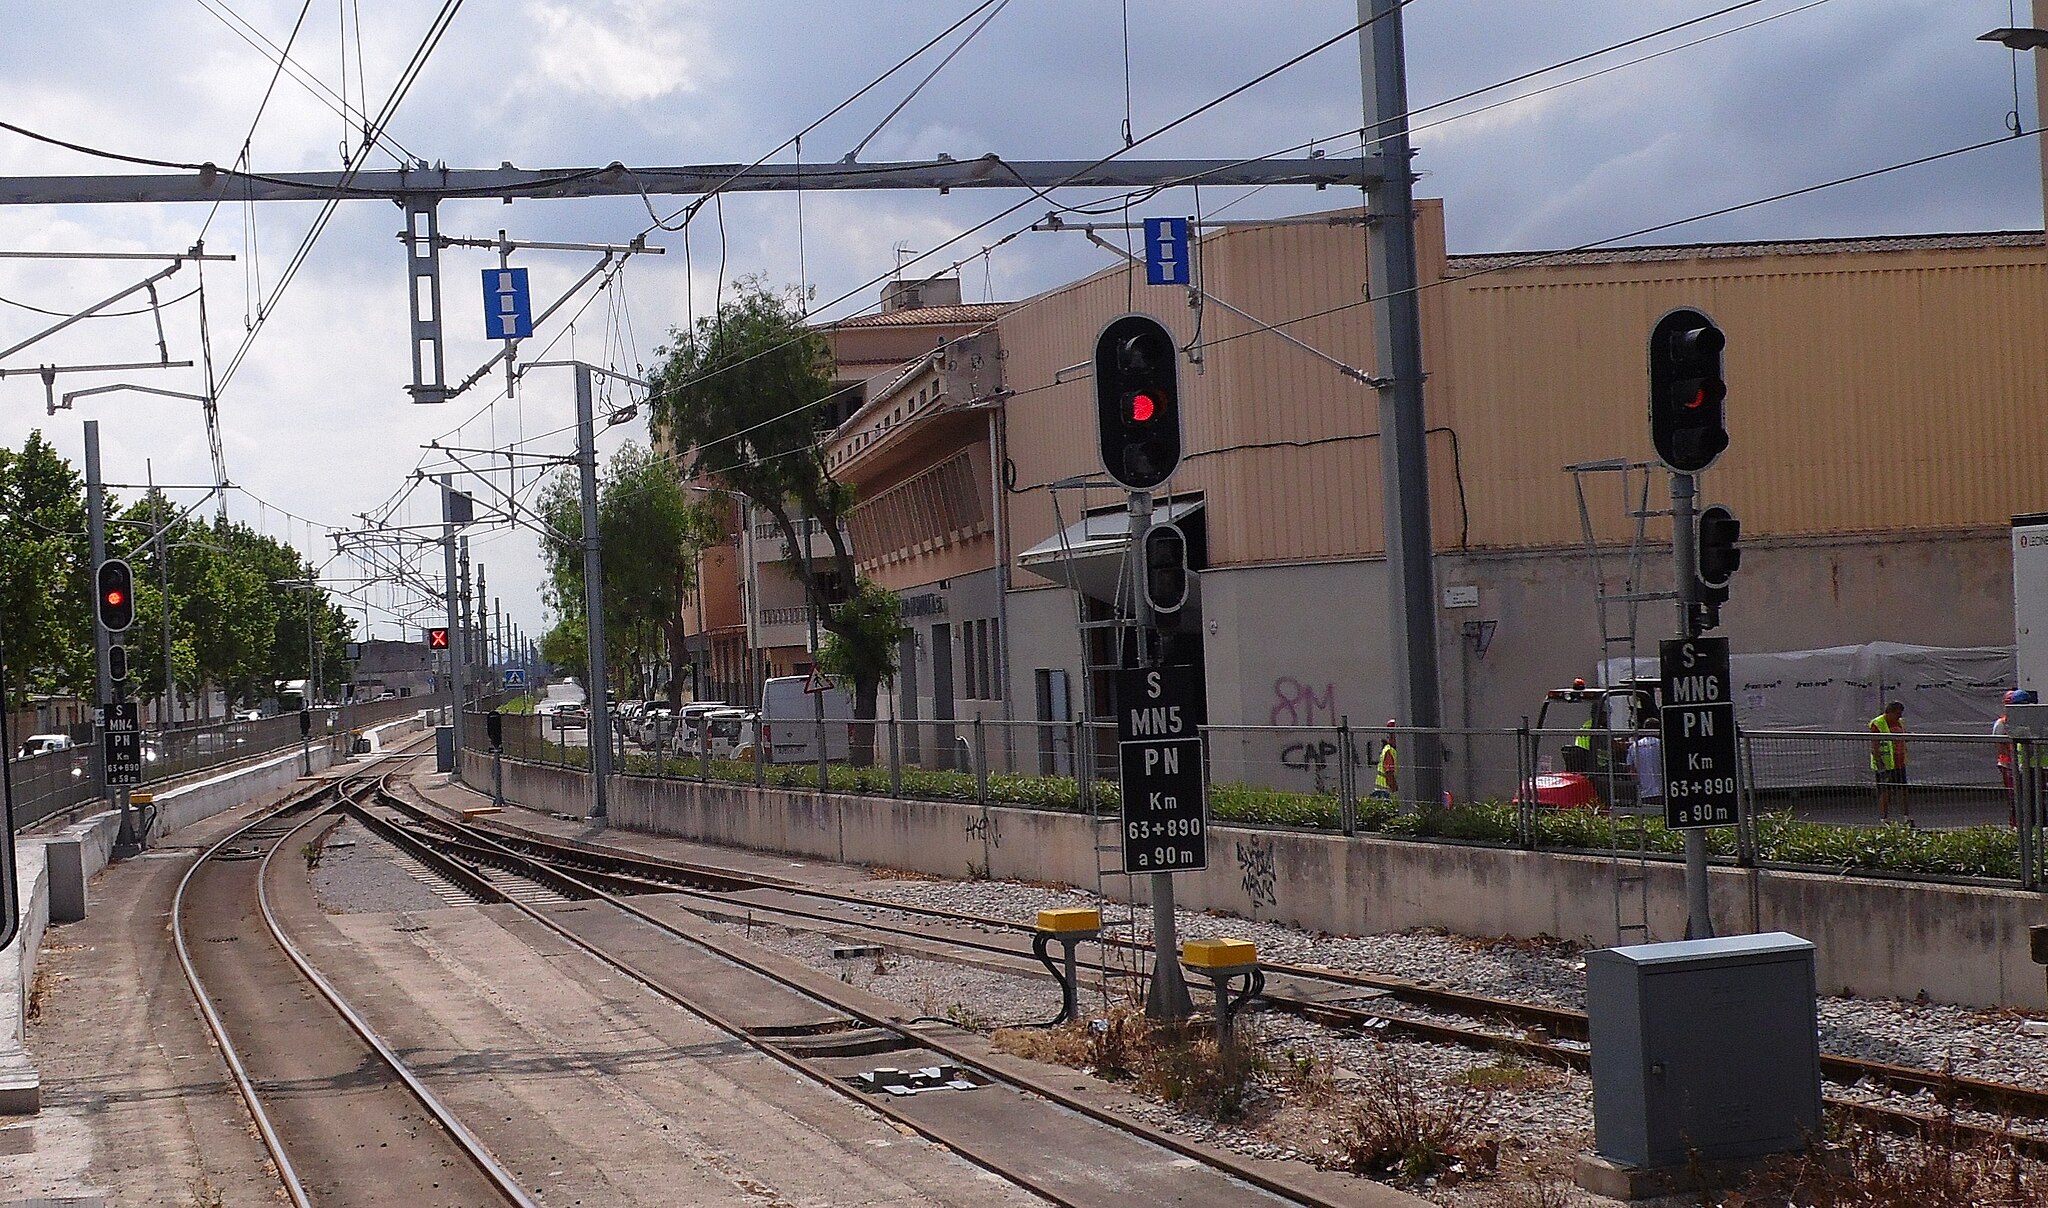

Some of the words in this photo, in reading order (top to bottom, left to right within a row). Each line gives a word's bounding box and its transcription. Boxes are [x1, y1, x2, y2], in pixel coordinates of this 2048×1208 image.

[1147, 672, 1161, 698] S
[1673, 675, 1719, 702] MN6
[116, 704, 123, 716] S
[110, 718, 132, 730] MN4
[1131, 706, 1182, 736] MN5
[1684, 712, 1714, 738] PN
[114, 734, 130, 746] PN
[1144, 747, 1178, 776] PN
[1688, 753, 1713, 770] Km
[1670, 778, 1734, 798] 63+890
[1150, 792, 1177, 810] Km
[1679, 810, 1688, 822] a
[1693, 804, 1712, 821] 90
[1716, 807, 1728, 820] m
[1128, 818, 1200, 840] 63+890
[1139, 854, 1148, 866] a
[1155, 847, 1176, 865] 90
[1180, 850, 1193, 863] m
